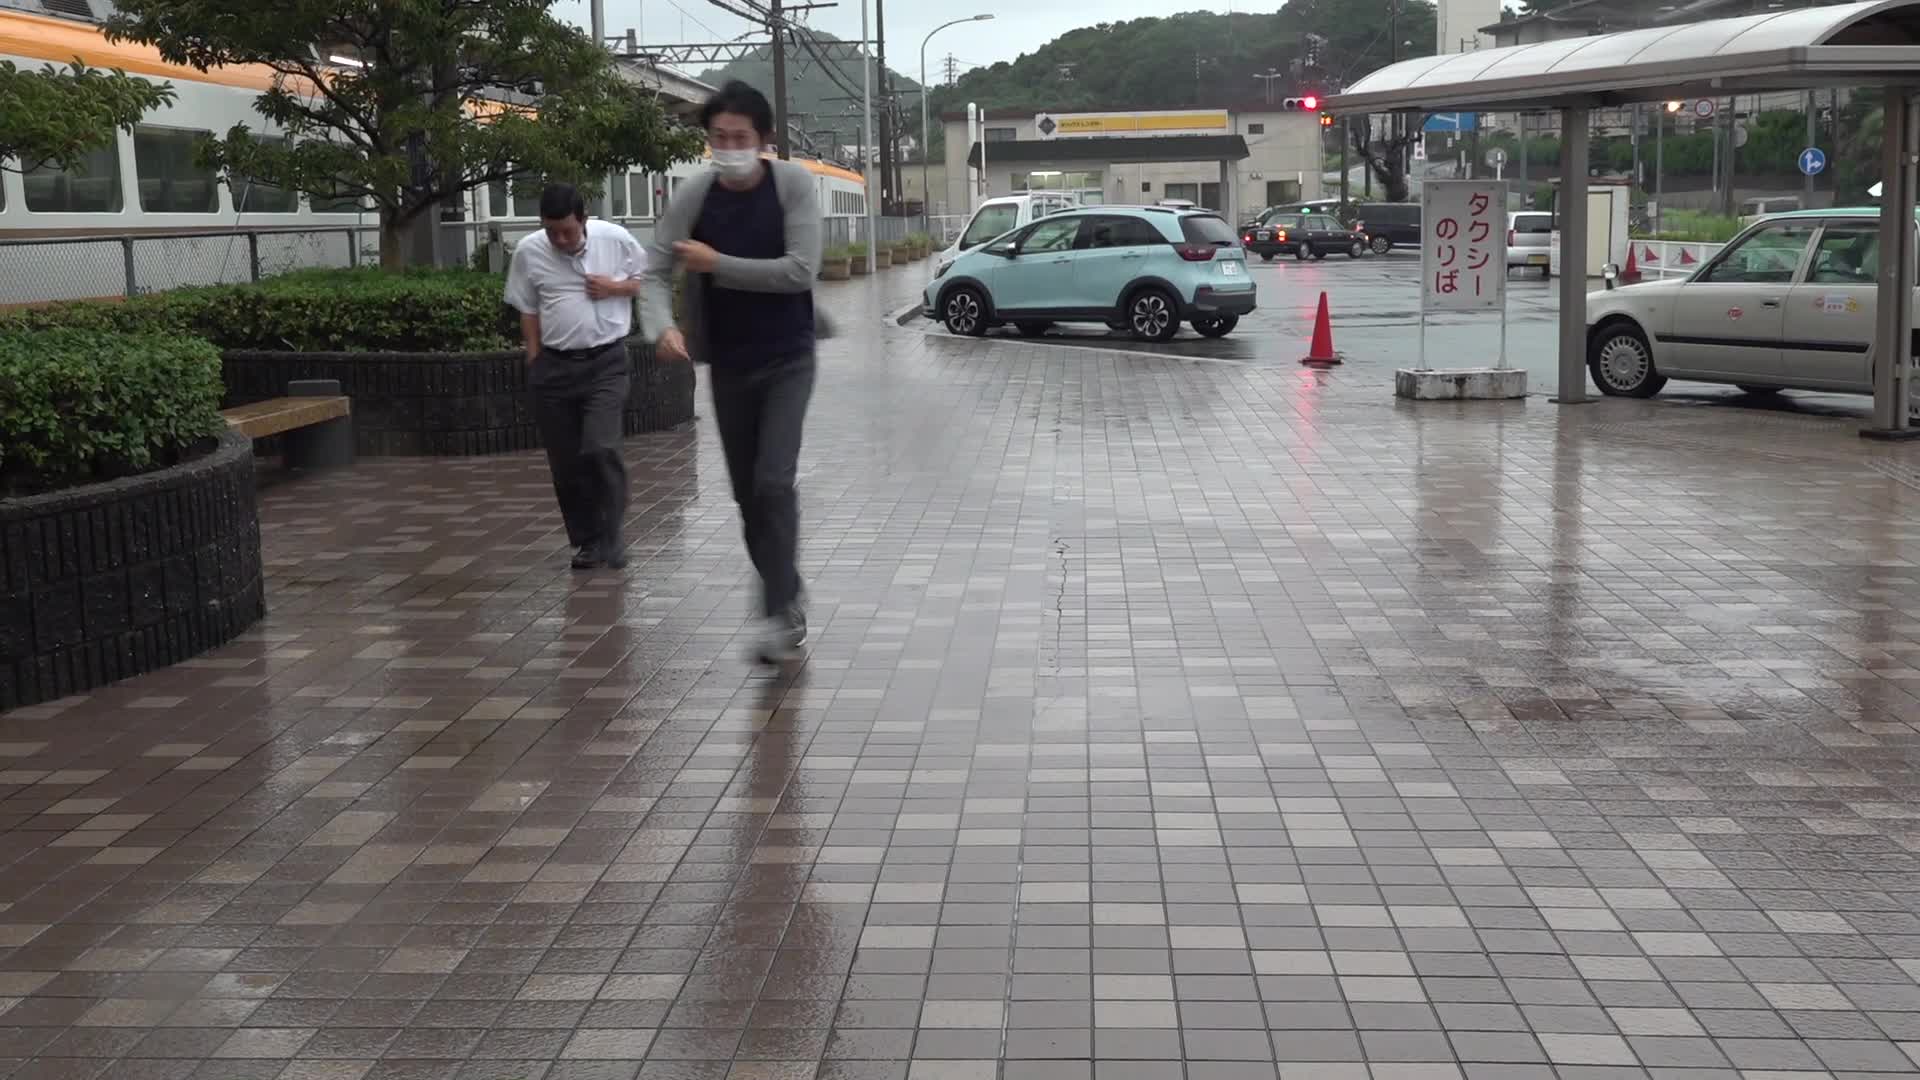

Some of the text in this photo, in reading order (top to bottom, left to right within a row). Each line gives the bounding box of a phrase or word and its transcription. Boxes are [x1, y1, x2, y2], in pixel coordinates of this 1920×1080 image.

[1435, 217, 1460, 294] のりば
[1467, 192, 1490, 297] タクシー
